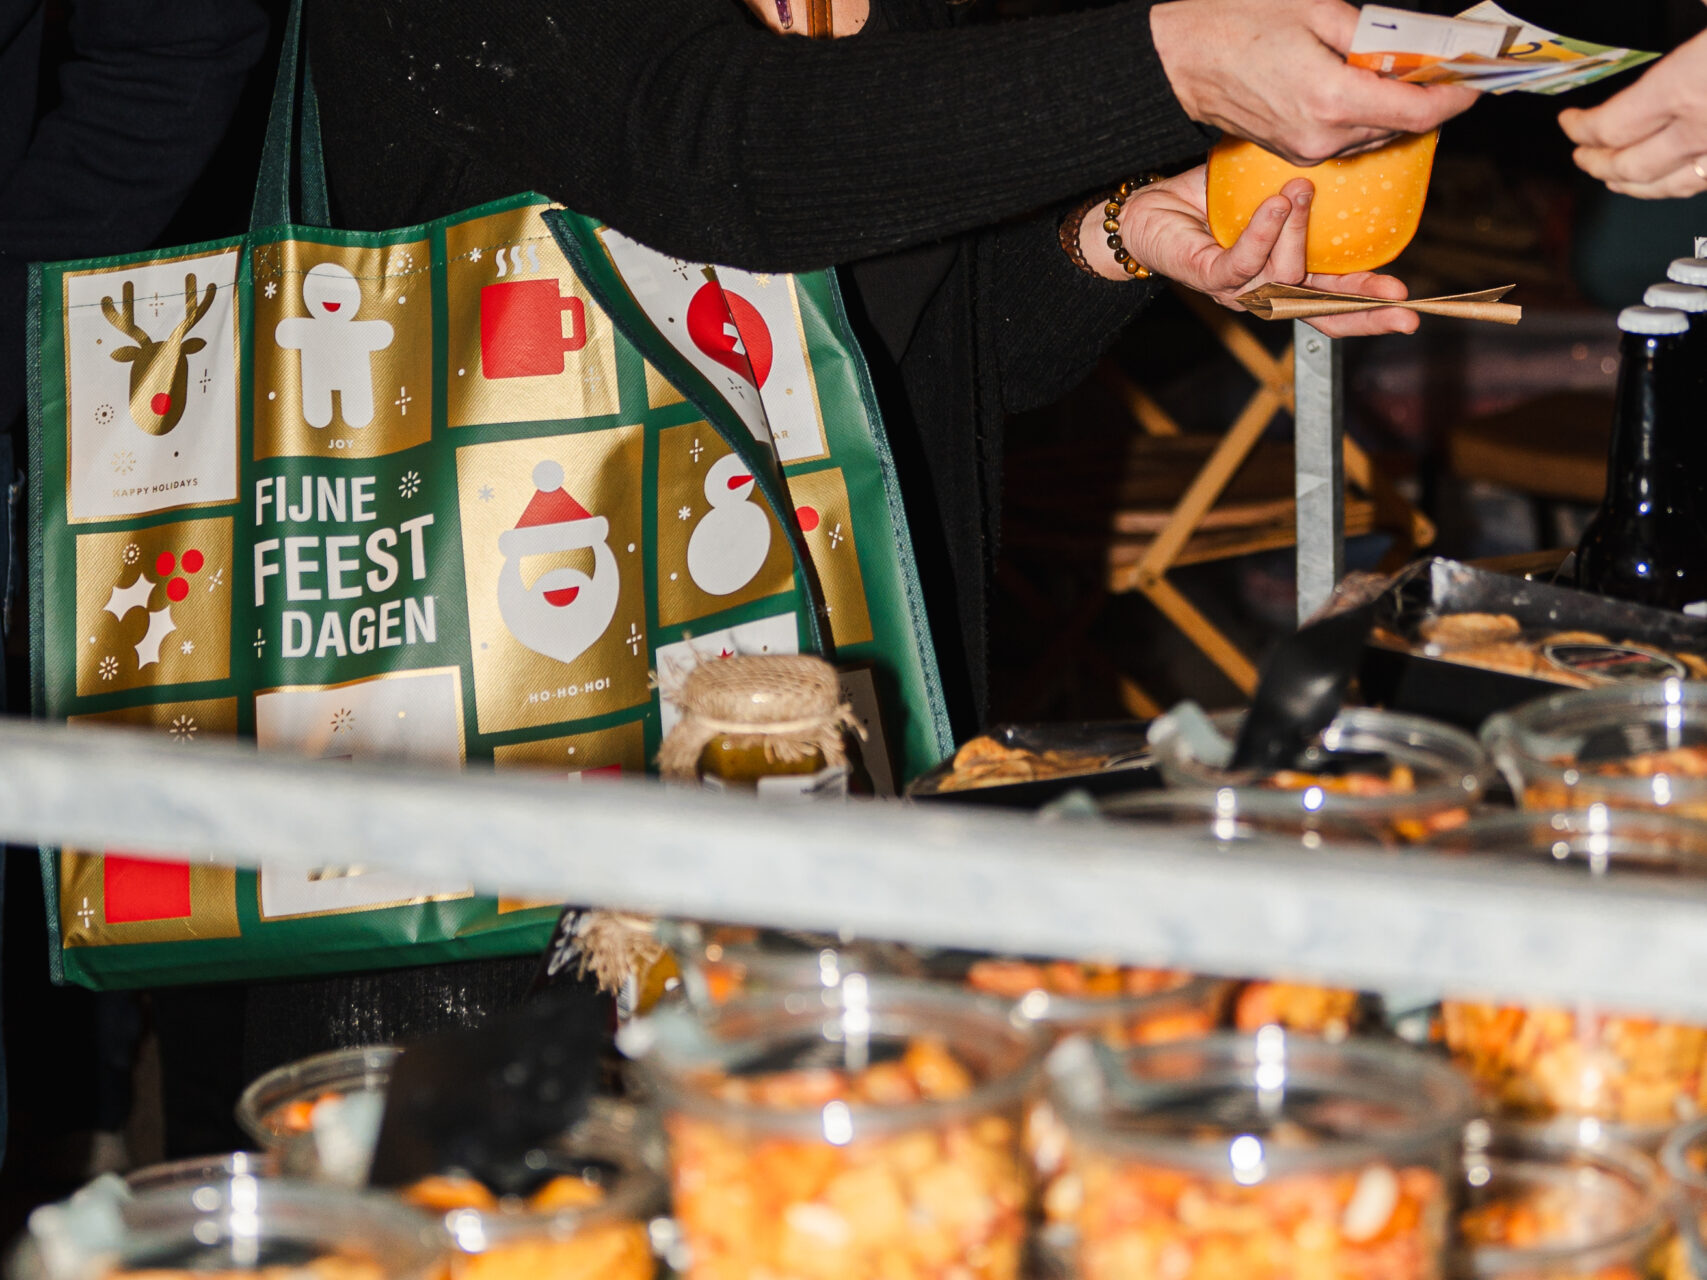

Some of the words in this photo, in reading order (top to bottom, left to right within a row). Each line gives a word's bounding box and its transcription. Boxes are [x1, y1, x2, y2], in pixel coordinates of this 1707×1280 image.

[328, 439, 354, 449] JOY
[112, 487, 149, 497] HAPPY
[152, 478, 198, 493] HOLIDAYS
[255, 475, 377, 526] FIJNE
[254, 514, 434, 607] FEEST
[281, 595, 437, 658] DAGEN
[529, 677, 610, 704] HO-HO-HO!
